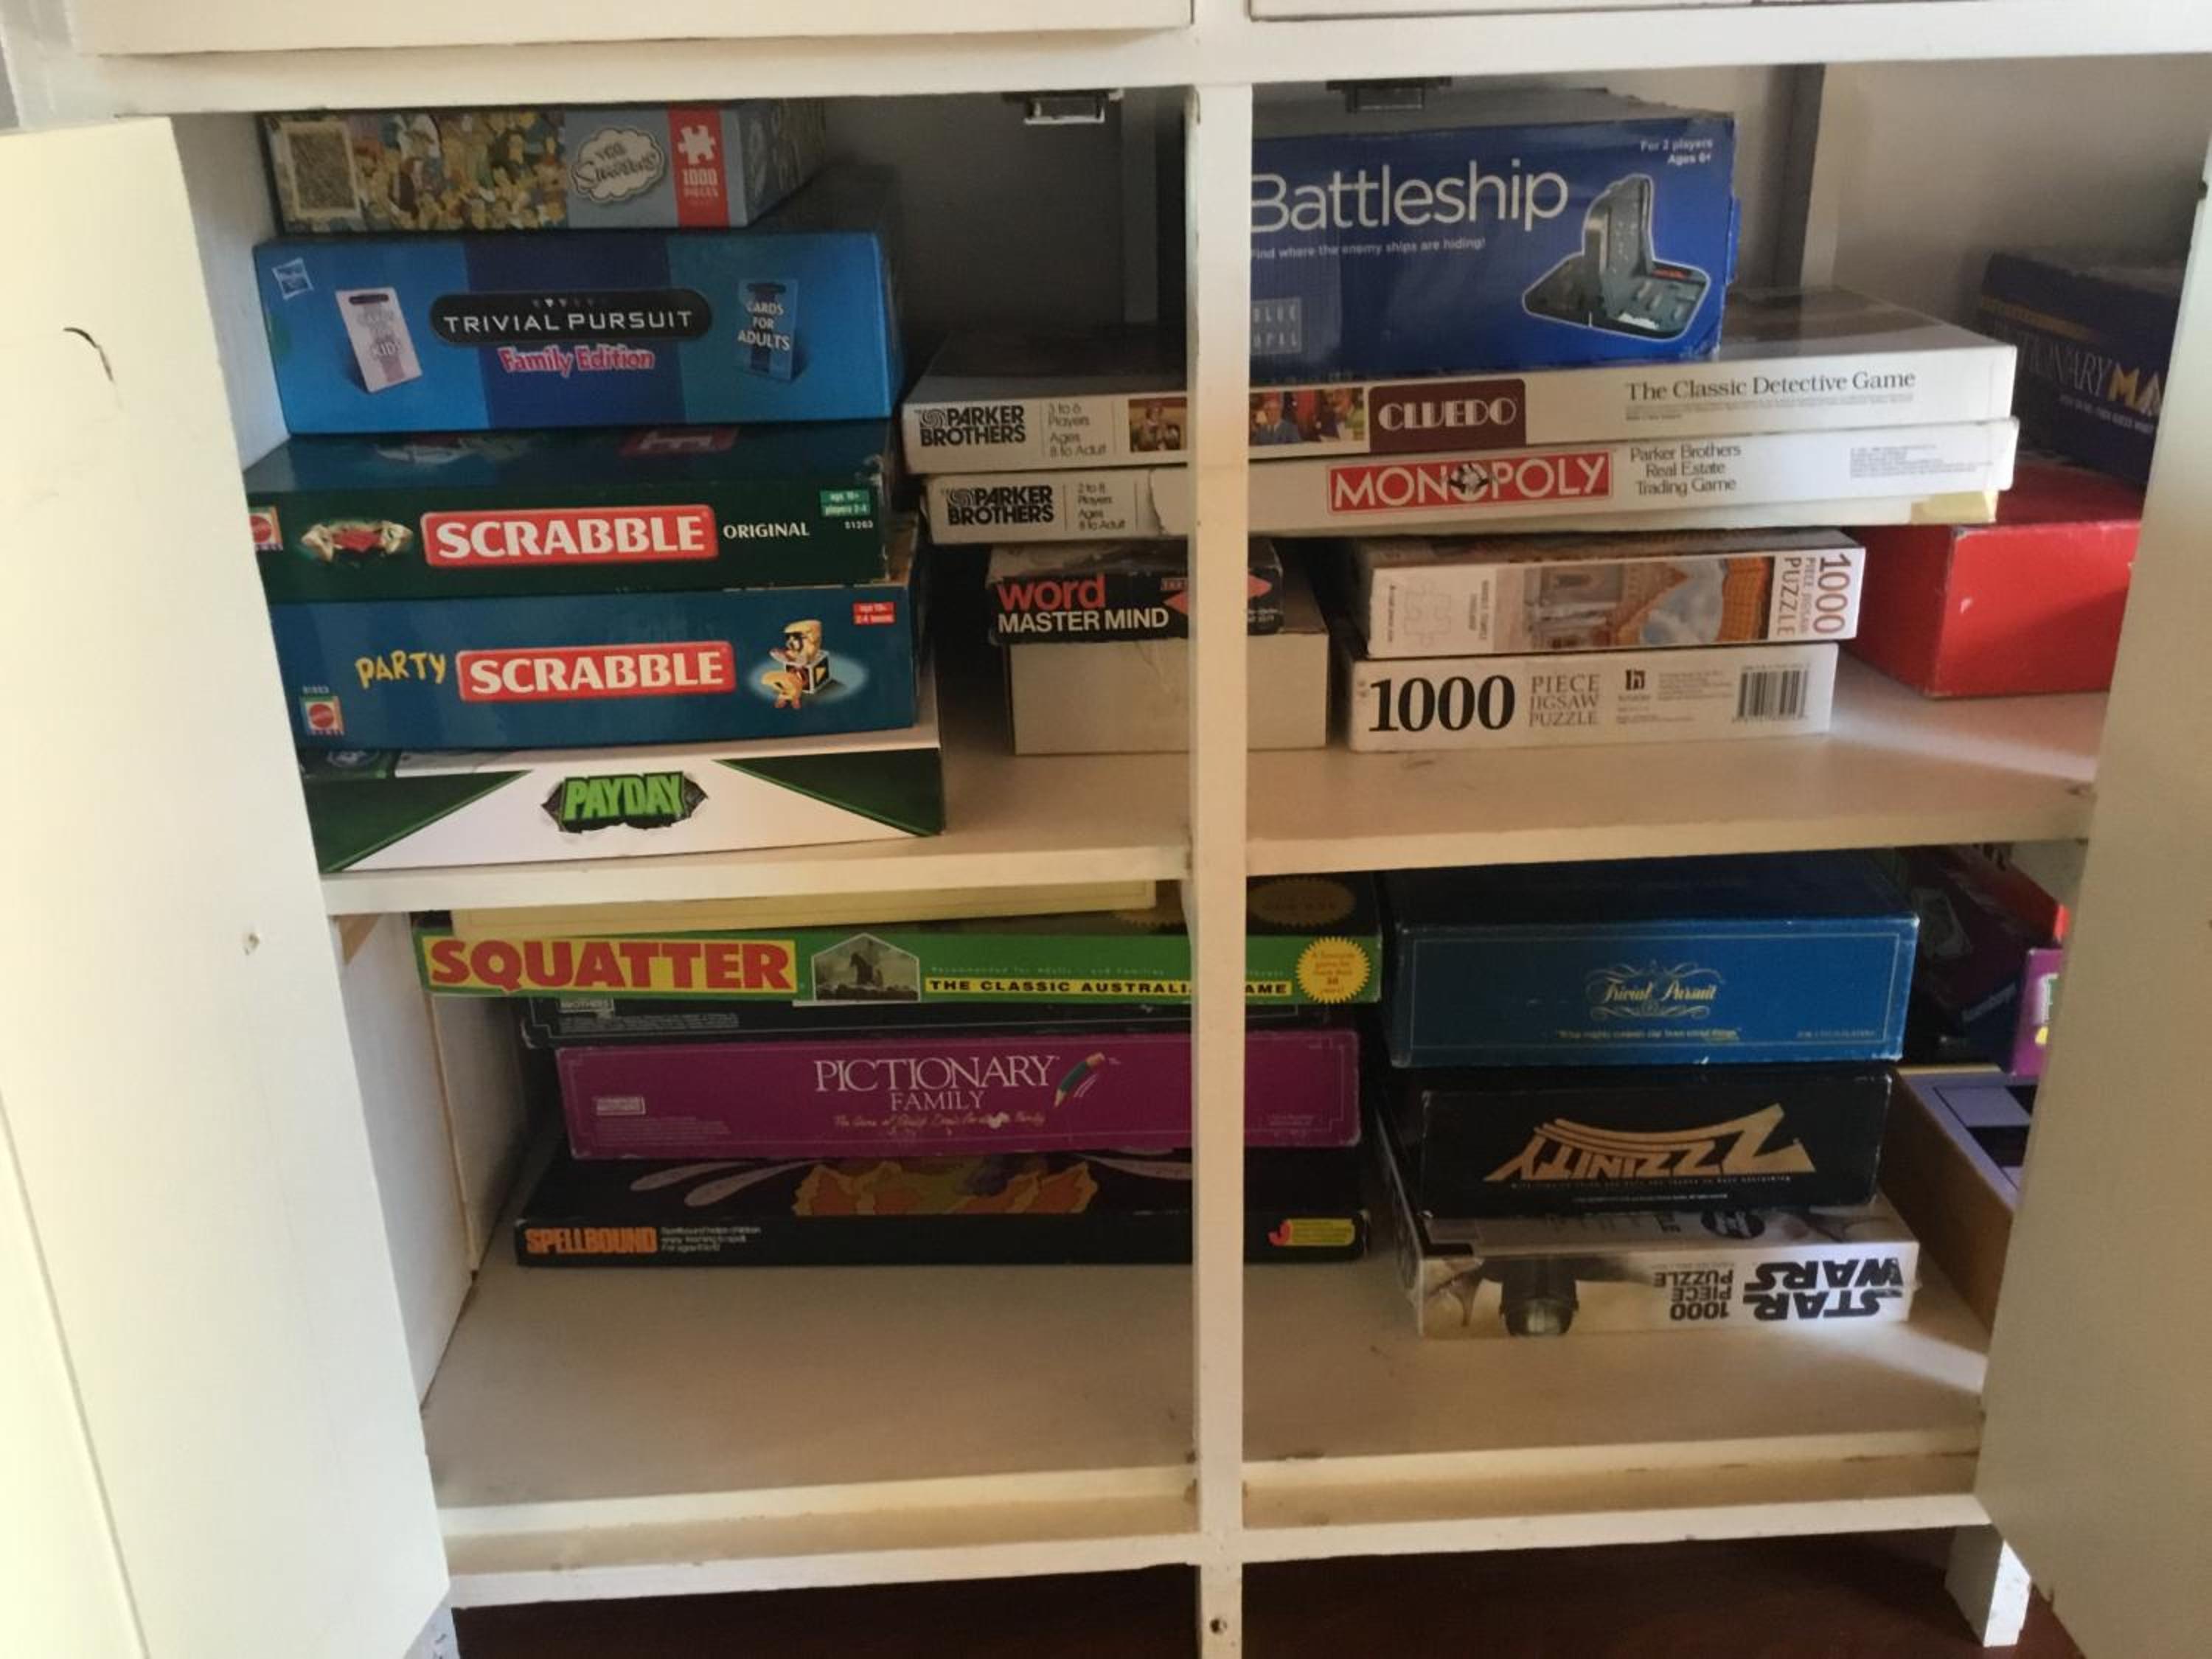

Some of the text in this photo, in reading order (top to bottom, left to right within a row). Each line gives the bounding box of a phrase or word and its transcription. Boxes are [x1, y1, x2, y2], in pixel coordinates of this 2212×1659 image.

[682, 168, 719, 186] 1000
[1250, 158, 1569, 233] Battleship
[1279, 246, 1315, 258] where
[1318, 244, 1338, 256] the
[1341, 243, 1381, 257] enemy
[1385, 240, 1416, 254] ships
[1421, 241, 1439, 251] are
[744, 301, 785, 316] CARDS
[443, 310, 693, 333] TRIVIAL PURSUIT
[753, 316, 775, 330] FOR
[737, 330, 790, 352] ADULTS
[498, 342, 655, 378] Family Edition
[1625, 369, 1916, 401] The Classic Detective Game
[2107, 361, 2163, 416] MA
[947, 405, 1025, 426] PARKER
[1058, 403, 1071, 414] to
[1378, 397, 1517, 431] CLUEDO
[1048, 414, 1091, 428] Players
[920, 425, 1027, 447] BROTHERS
[1050, 432, 1080, 444] Ages
[1060, 445, 1073, 457] to
[1076, 443, 1107, 456] Adult
[1630, 442, 1742, 462] Parker Brothers
[1646, 461, 1726, 479] Real Estate
[1335, 455, 1605, 509] MONOPOLY
[1636, 477, 1737, 496] Trading Game
[973, 484, 1053, 507] PARKER
[1077, 495, 1113, 507] Players
[947, 504, 1055, 525] BROTHERS
[1079, 509, 1104, 520] Ages
[1100, 519, 1127, 531] Adult
[437, 516, 705, 559] SCRABBLE
[723, 521, 810, 539] ORIGINAL
[998, 574, 1105, 612] word
[1776, 557, 1802, 636] PUZZLE
[1812, 552, 1852, 634] 1000
[998, 607, 1169, 633] MASTER MIND
[355, 650, 446, 689] PARTY
[470, 652, 724, 695] SCRABBLE
[1531, 673, 1601, 693] PIECE
[1368, 675, 1515, 732] 1000
[1529, 693, 1599, 712] JIGSAW
[1528, 710, 1599, 728] PUZZLE
[563, 772, 684, 821] PAYDAY
[431, 939, 792, 992] SQUATTER
[930, 980, 969, 990] THE
[981, 980, 1069, 991] CLASSIC
[1081, 981, 1192, 994] AUSTRALI
[1604, 977, 1718, 1004] Trivial Pursuit
[814, 1056, 1054, 1092] PICTIONARY
[891, 1091, 985, 1112] FAMILY
[1482, 1103, 1816, 1183] ZZZINITY
[526, 1227, 658, 1253] SPELLBOUND
[1653, 1268, 1734, 1289] PUZZLE
[1744, 1258, 1904, 1292] WARS
[1671, 1285, 1733, 1304] PIECE
[1743, 1290, 1903, 1321] STAR
[1669, 1301, 1729, 1321] 1000
